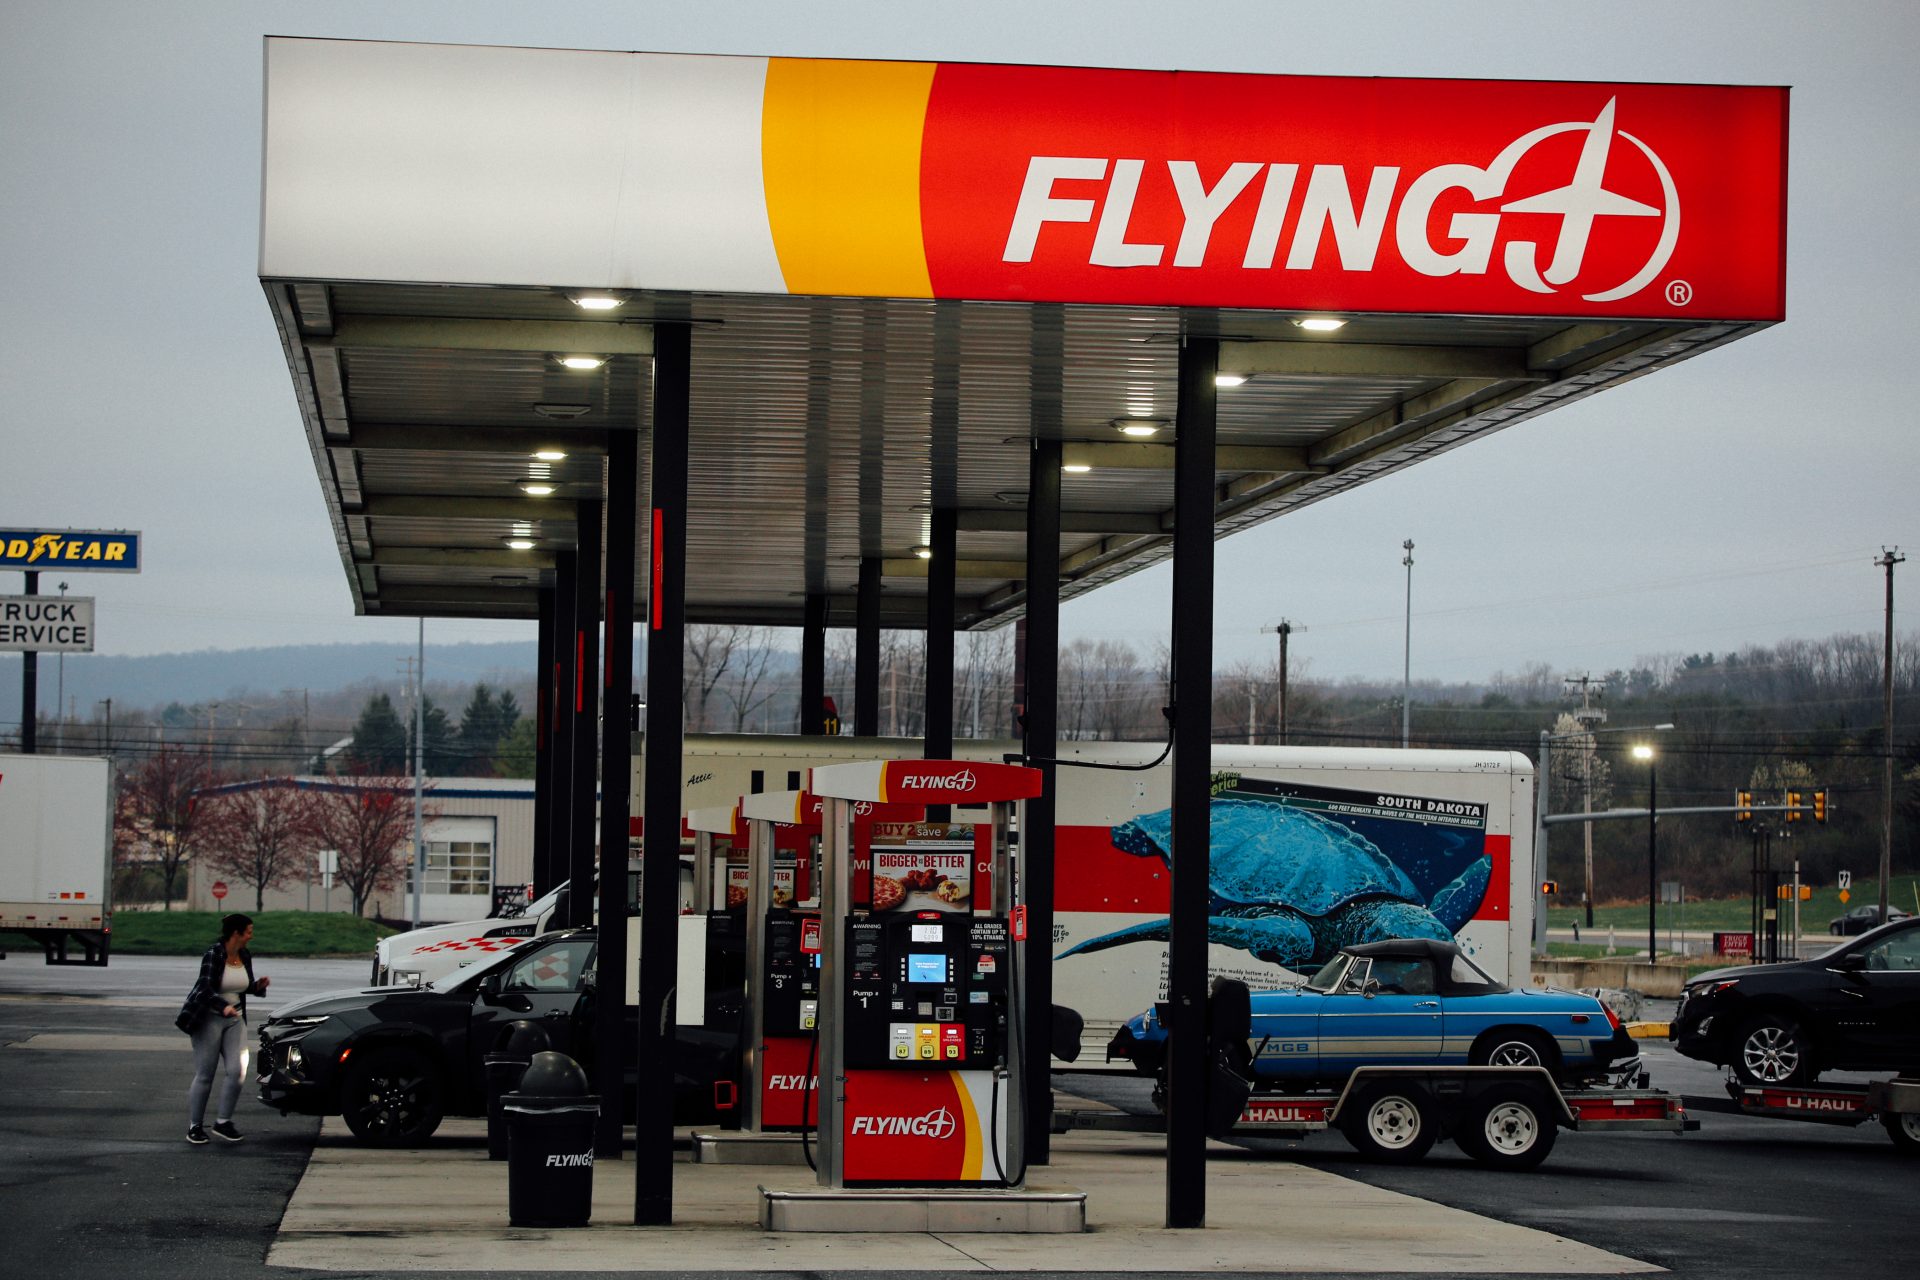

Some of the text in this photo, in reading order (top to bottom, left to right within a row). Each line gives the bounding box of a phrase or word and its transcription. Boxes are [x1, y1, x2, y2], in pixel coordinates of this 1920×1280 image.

[0, 539, 127, 561] DYEAR
[0, 603, 76, 622] RUCK
[823, 718, 838, 735] 11
[686, 773, 713, 787] Attic
[1377, 795, 1480, 817] SOUTH DAKOTA
[1351, 806, 1372, 814] BENEATH
[1381, 809, 1398, 817] WAVES
[1416, 813, 1438, 821] WESTERN
[1438, 816, 1460, 824] INTERIOR
[1461, 818, 1480, 826] SEAWAY
[872, 824, 905, 836] BUY
[907, 824, 916, 836] 2
[879, 855, 918, 867] BIGGER
[924, 855, 965, 868] BETTER
[775, 979, 783, 989] 3
[860, 997, 867, 1008] 1
[1267, 1043, 1309, 1052] MGB
